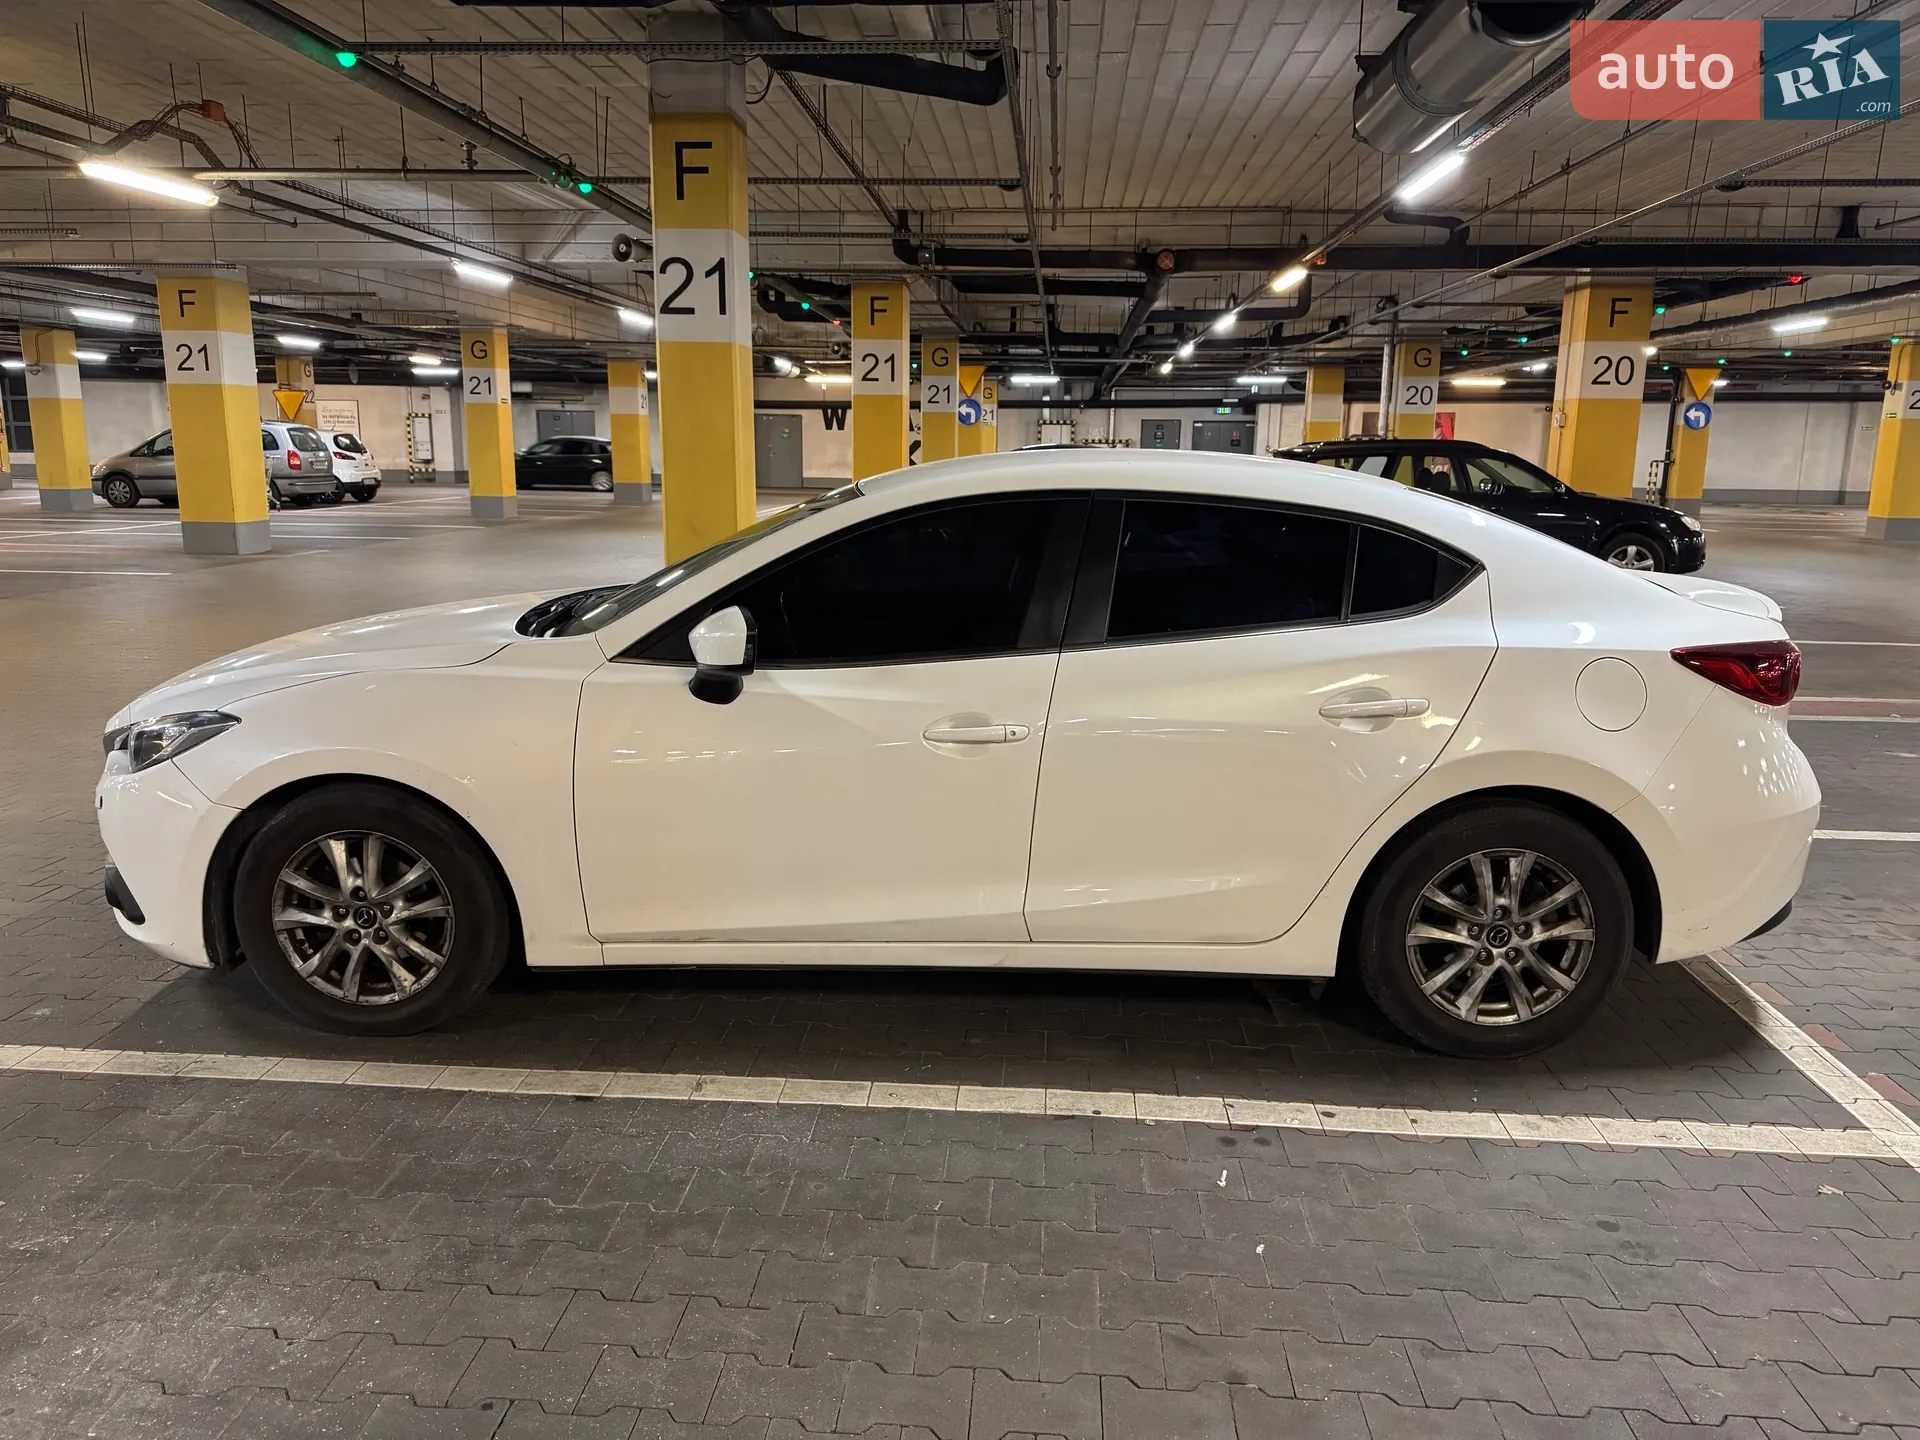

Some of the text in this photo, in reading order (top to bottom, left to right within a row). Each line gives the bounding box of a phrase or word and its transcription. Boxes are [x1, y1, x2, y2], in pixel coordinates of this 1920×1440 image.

[674, 141, 712, 200] F
[658, 256, 727, 316] 21
[178, 289, 197, 318] F
[870, 296, 890, 326] F
[1609, 297, 1633, 329] F
[176, 343, 210, 372] 21
[470, 339, 488, 360] G
[931, 347, 949, 367] G
[1413, 347, 1432, 368] G
[304, 363, 312, 378] G
[861, 353, 896, 382] 21
[1590, 355, 1635, 386] 20
[470, 375, 492, 395] 21
[927, 384, 951, 404] 21
[983, 386, 993, 400] G
[1404, 385, 1434, 406] 20
[1908, 389, 1920, 410] 2
[982, 408, 994, 421] 21
